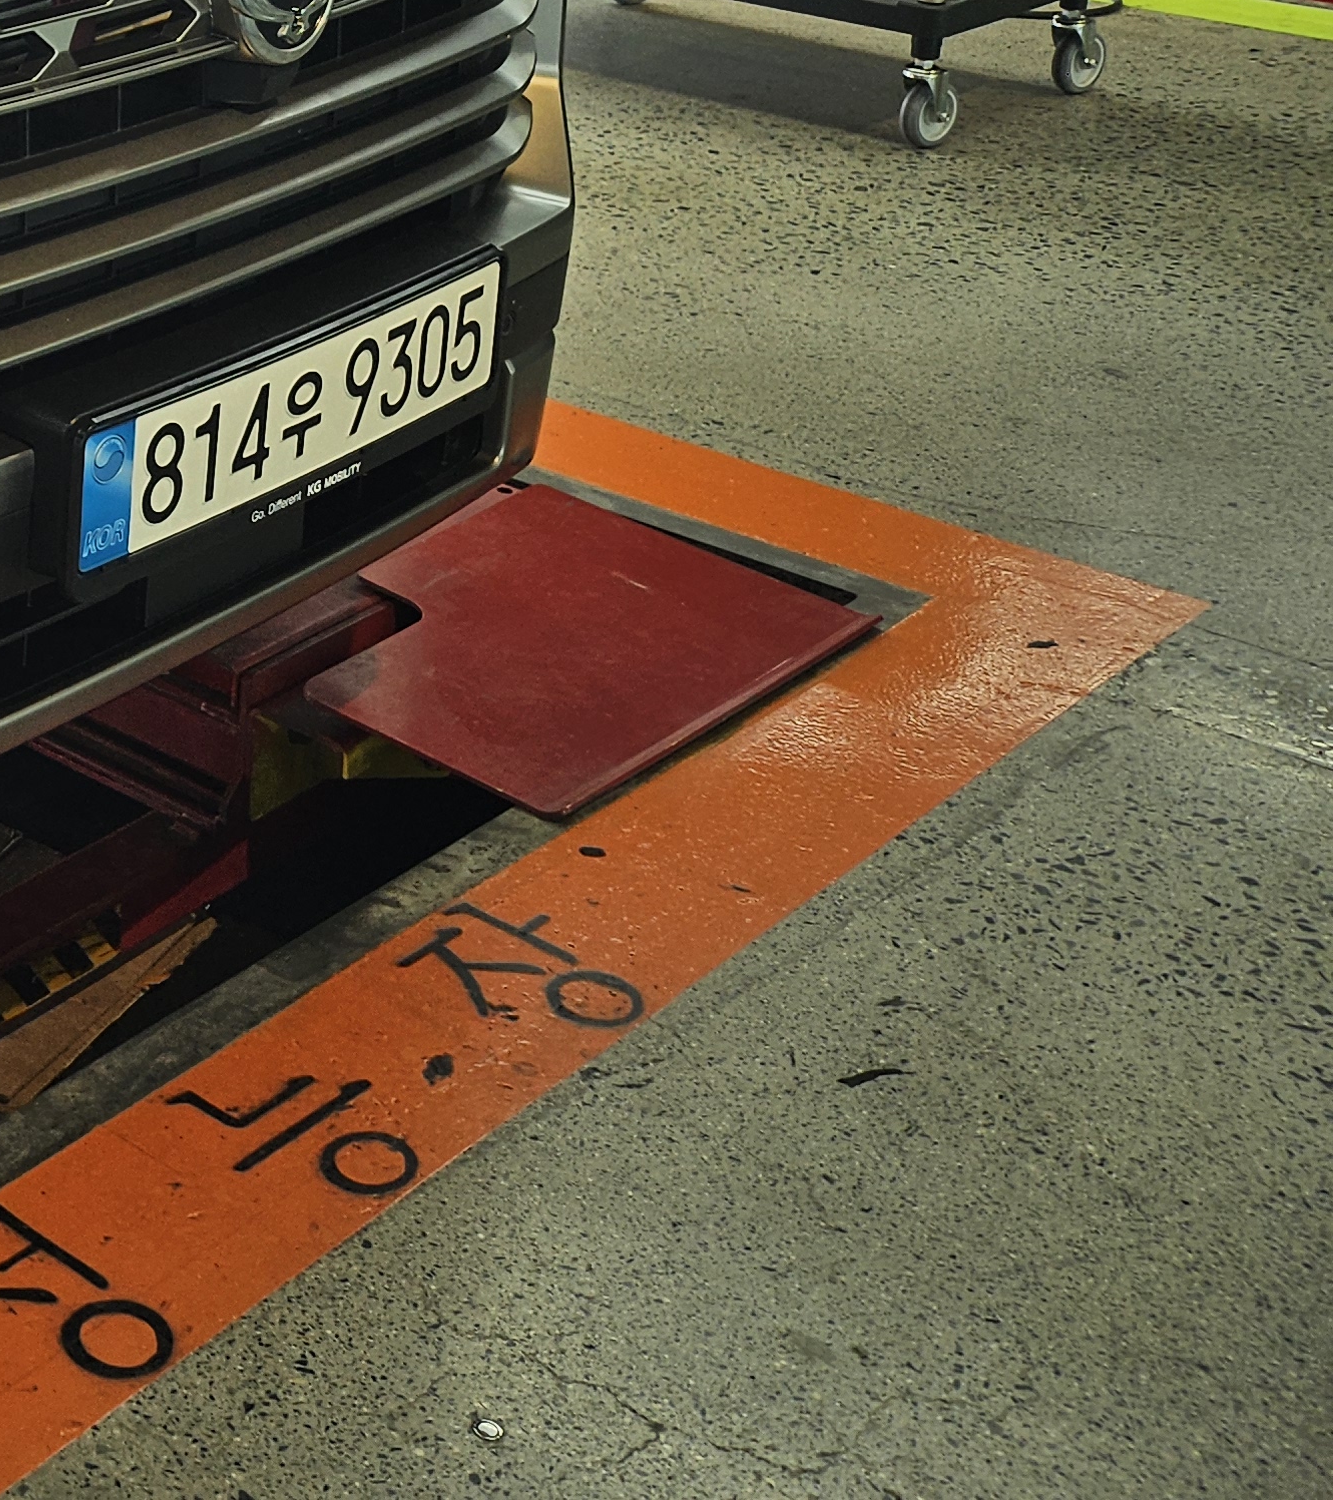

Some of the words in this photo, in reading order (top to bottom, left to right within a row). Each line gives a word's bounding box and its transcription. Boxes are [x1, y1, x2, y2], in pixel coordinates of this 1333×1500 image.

[140, 370, 322, 525] 814우
[345, 285, 486, 437] 9305
[268, 490, 302, 516] Different
[307, 479, 322, 497] KG
[324, 461, 362, 489] MOBILITY
[82, 518, 126, 558] KOR
